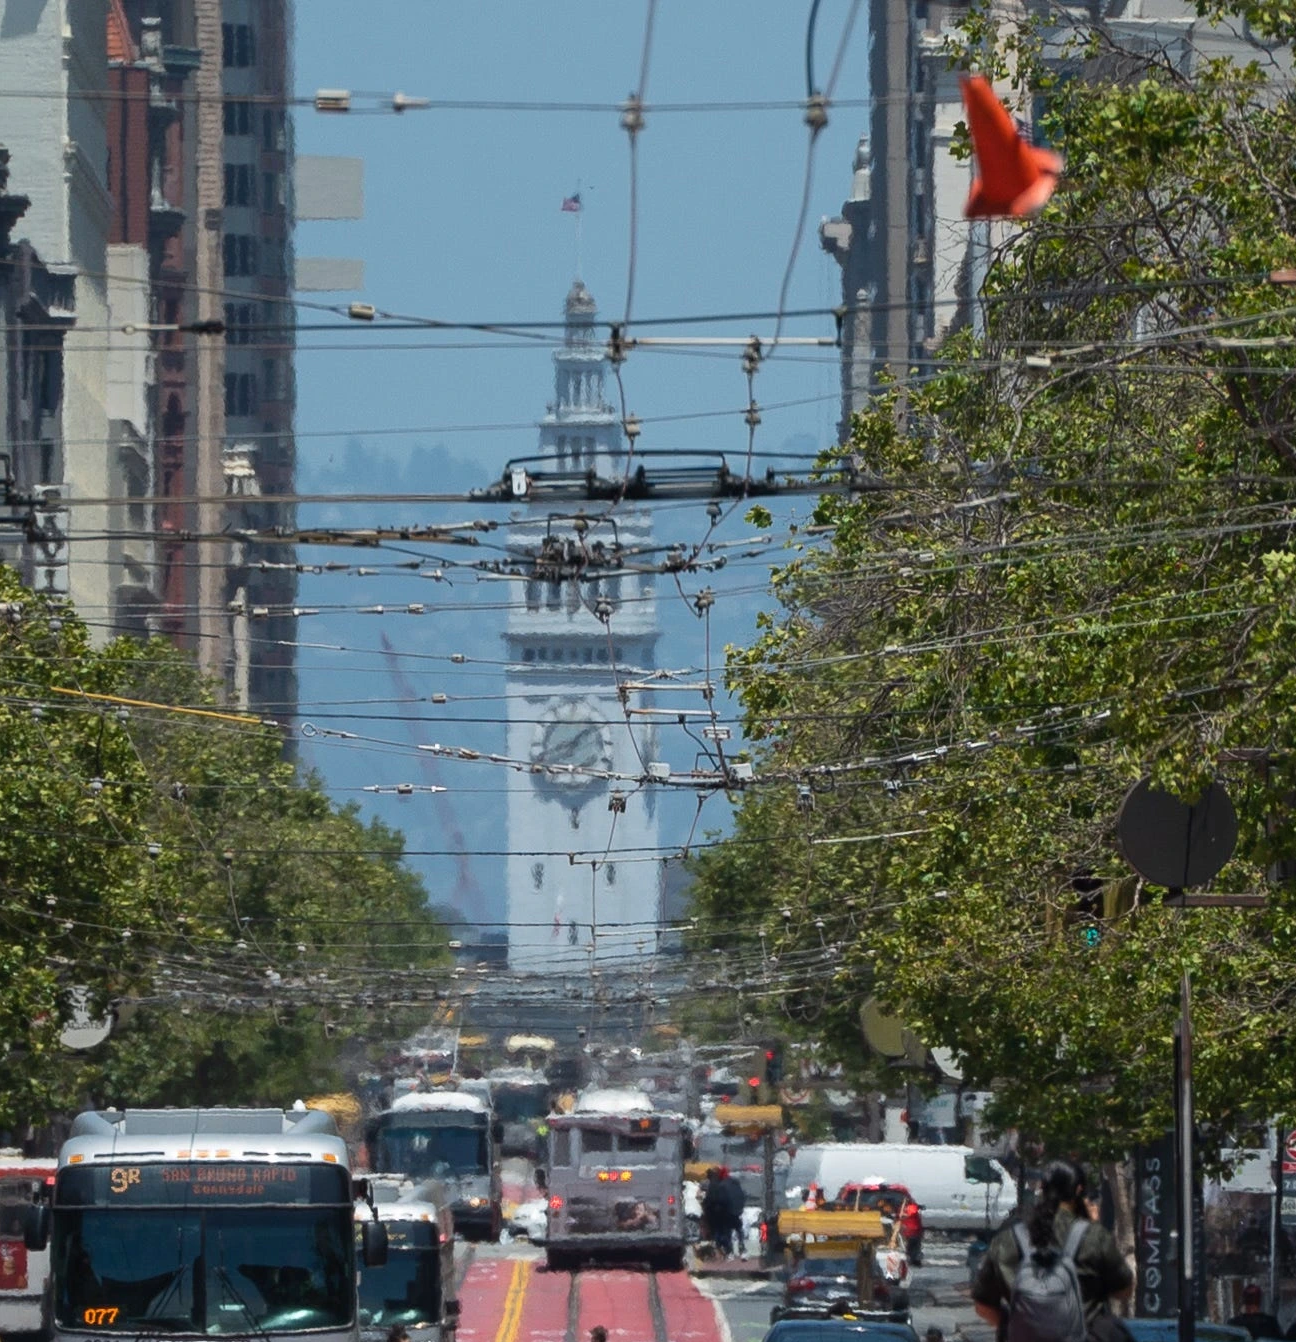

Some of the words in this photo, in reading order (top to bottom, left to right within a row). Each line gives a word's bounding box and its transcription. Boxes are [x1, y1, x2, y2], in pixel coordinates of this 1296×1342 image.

[110, 1167, 140, 1193] 9R
[162, 1167, 191, 1182] SAN
[252, 1168, 297, 1182] RAPID
[1142, 1156, 1163, 1314] COMPASS
[83, 1307, 120, 1325] 077
